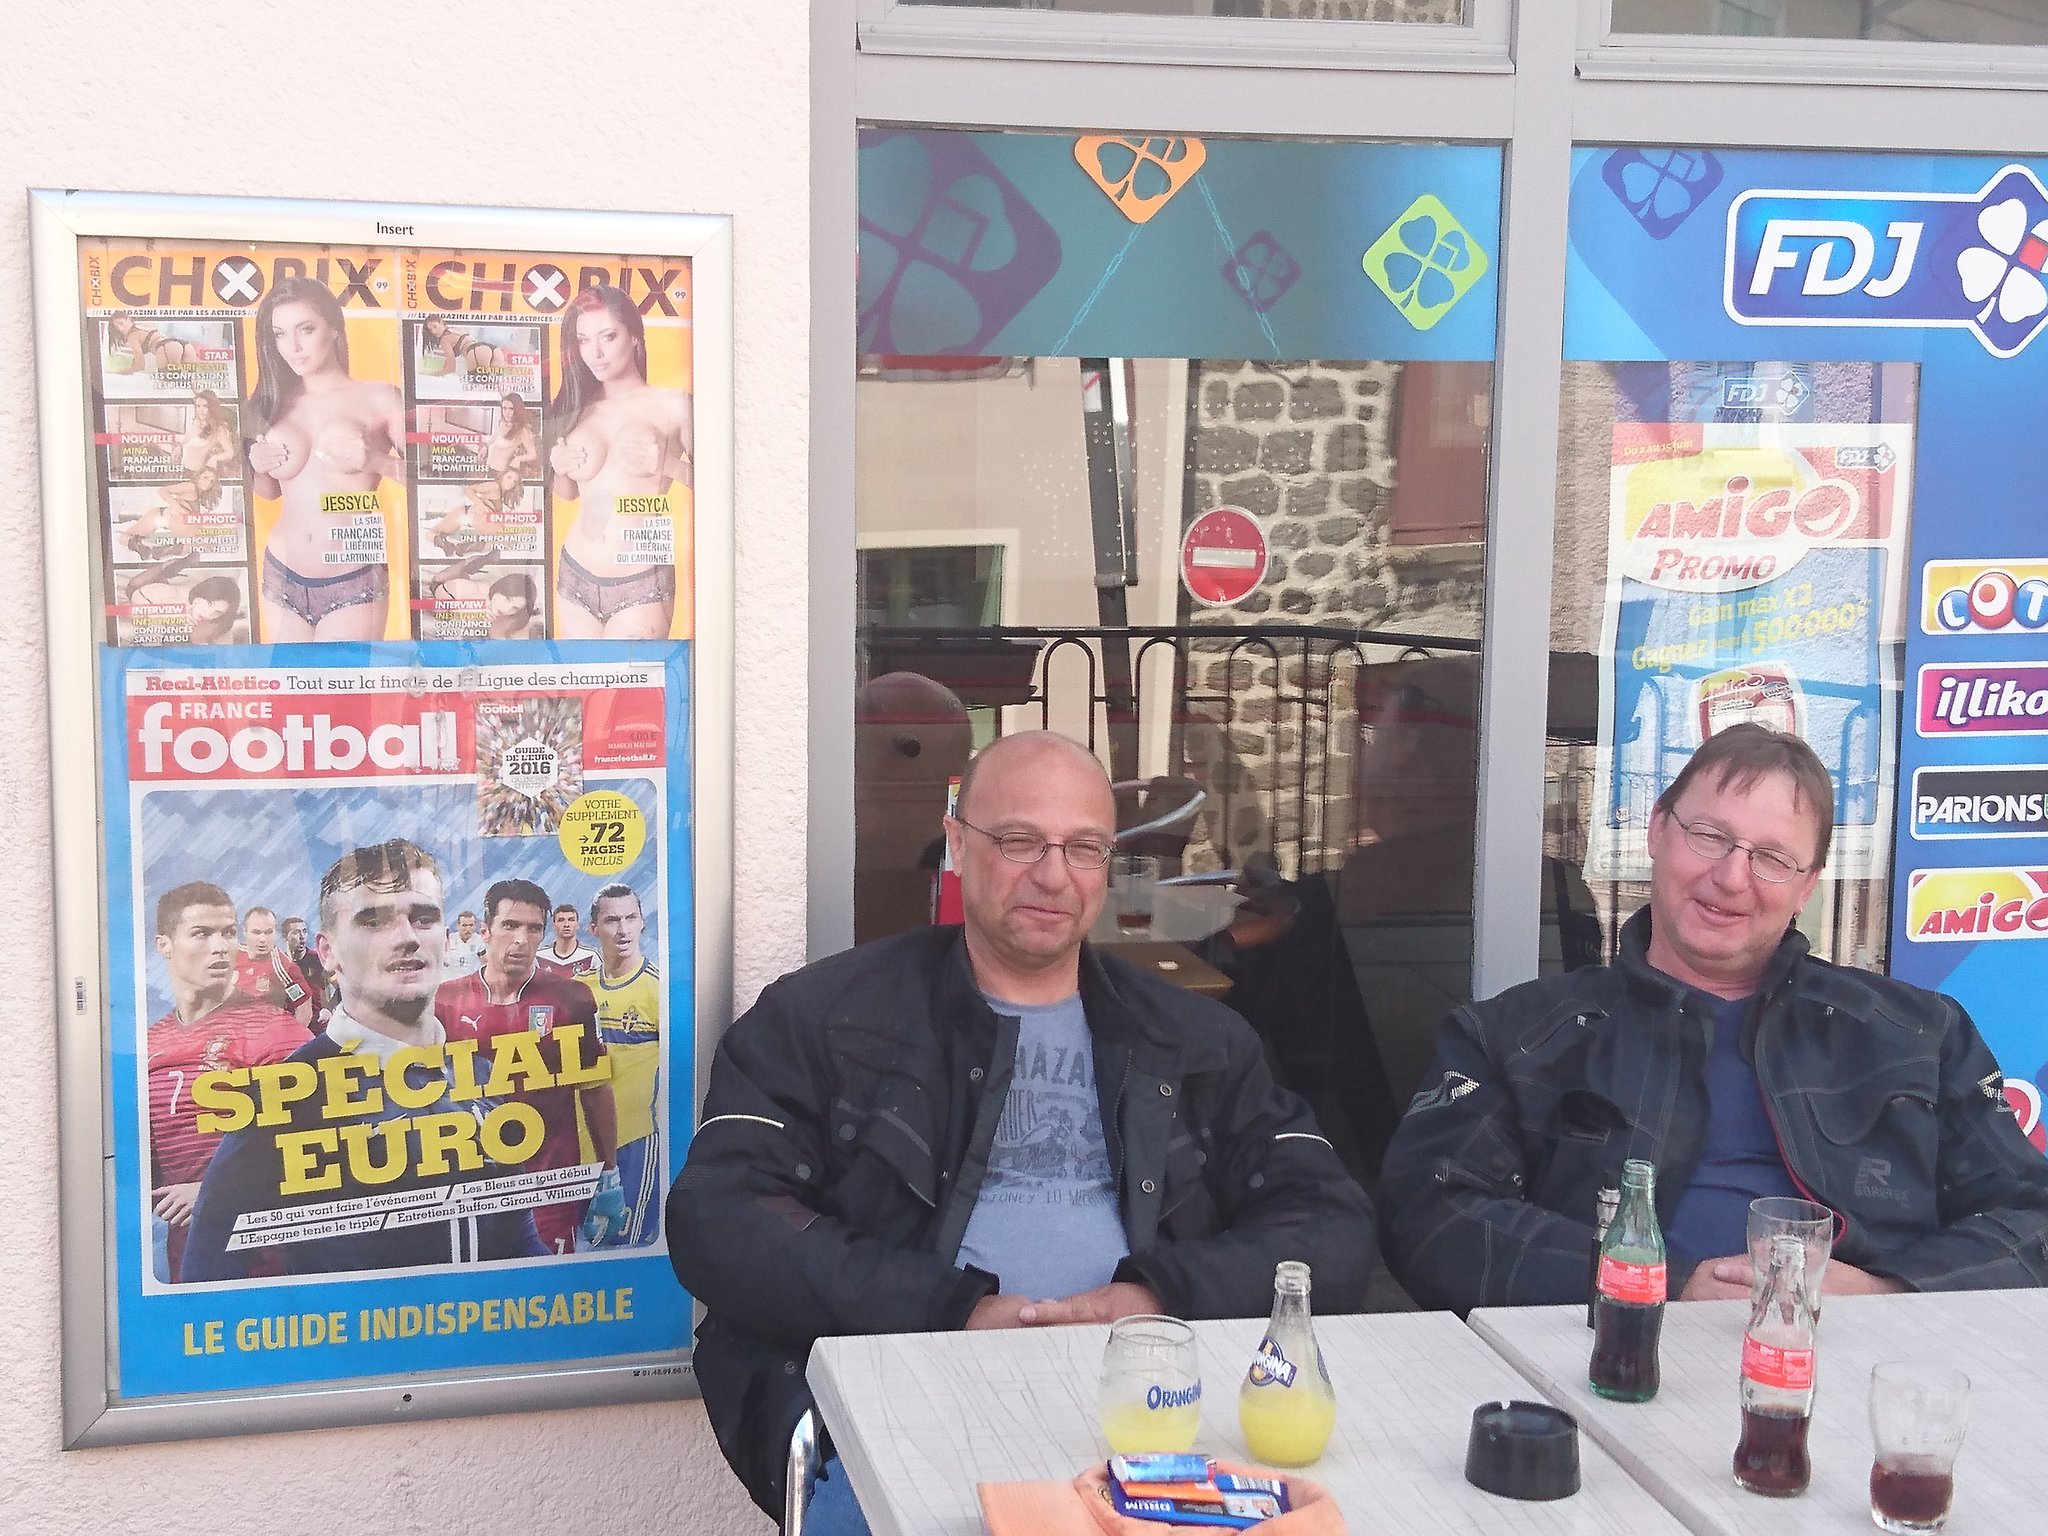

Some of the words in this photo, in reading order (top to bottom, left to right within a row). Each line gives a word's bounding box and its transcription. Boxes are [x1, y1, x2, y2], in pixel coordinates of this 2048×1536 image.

[376, 222, 415, 235] Insert
[1749, 219, 1924, 298] FDJ
[204, 351, 229, 360] STAR
[511, 355, 535, 364] STAR
[1727, 383, 1769, 403] FDJ
[121, 434, 174, 444] NOUVELLE
[431, 434, 480, 444] NOUVELLE
[123, 447, 149, 455] MINA
[432, 446, 456, 454] MINA
[1839, 449, 1870, 464] FDJ
[322, 494, 380, 512] JESSYCA
[616, 497, 670, 513] JESSYCA
[187, 515, 201, 524] EN
[203, 515, 238, 523] PHOTO
[354, 517, 363, 526] LA
[365, 516, 382, 525] STAR
[490, 514, 503, 523] EN
[504, 514, 538, 523] PHOTO
[645, 519, 654, 528] LA
[655, 518, 672, 527] STAR
[331, 527, 384, 543] FRANÇAISE
[623, 529, 673, 544] FRANÇAISE
[213, 546, 240, 554] HARD
[345, 541, 384, 551] LIBERTINE
[513, 544, 537, 552] HARD
[635, 542, 672, 552] LIBERTINE
[324, 553, 338, 563] QUI
[340, 553, 380, 563] CARTONNE
[616, 553, 629, 563] QUI
[630, 553, 668, 564] CARTONNE
[131, 605, 184, 615] INTERVIEW
[434, 600, 484, 609] INTERVIEW
[1689, 600, 1733, 627] Gain
[133, 626, 194, 634] CONFIDENCES
[435, 620, 493, 629] CONFIDENCES
[435, 629, 458, 637] SANS
[133, 635, 157, 643] SANS
[1632, 638, 1708, 673] Gagnez
[145, 675, 281, 691] Real-Atletico
[287, 675, 325, 690] Tout
[328, 678, 356, 690] sur
[359, 673, 376, 690] la
[432, 673, 453, 688] de
[477, 672, 525, 690] Ligue
[527, 671, 557, 687] des
[560, 671, 648, 688] champions
[180, 702, 273, 720] FRANCE
[479, 703, 524, 714] football
[138, 701, 458, 774] football
[514, 746, 546, 754] GUIDE
[505, 754, 520, 762] DE
[521, 753, 555, 761] L'EURO
[593, 753, 658, 763] francefootball.fr
[509, 761, 551, 776] 2016
[584, 798, 622, 810] VOTRE
[590, 822, 626, 844] 72
[580, 844, 626, 855] PAGES
[582, 855, 624, 867] INCLUS
[190, 1023, 613, 1134] SPÉCIAL
[274, 1101, 546, 1196] EURO
[462, 1184, 482, 1195] Les
[485, 1179, 516, 1191] Bleus
[518, 1177, 533, 1187] au
[535, 1172, 558, 1185] tout
[560, 1166, 592, 1180] début
[246, 1214, 268, 1225] Les
[270, 1211, 284, 1222] 50
[286, 1209, 305, 1224] qui
[308, 1205, 334, 1217] vont
[336, 1200, 364, 1213] faire
[366, 1190, 437, 1205] l'événement
[397, 1207, 456, 1223] Entretiens
[458, 1201, 497, 1213] Buffon,
[500, 1193, 542, 1208] Giroud,
[545, 1186, 591, 1200] Wilmots
[239, 1228, 300, 1246] L'Espagne
[302, 1224, 333, 1237] tente
[335, 1221, 347, 1232] le
[349, 1215, 380, 1233] triplé
[184, 1319, 225, 1357] LE
[236, 1311, 348, 1353] GUIDE
[360, 1287, 634, 1342] INDISPENSABLE
